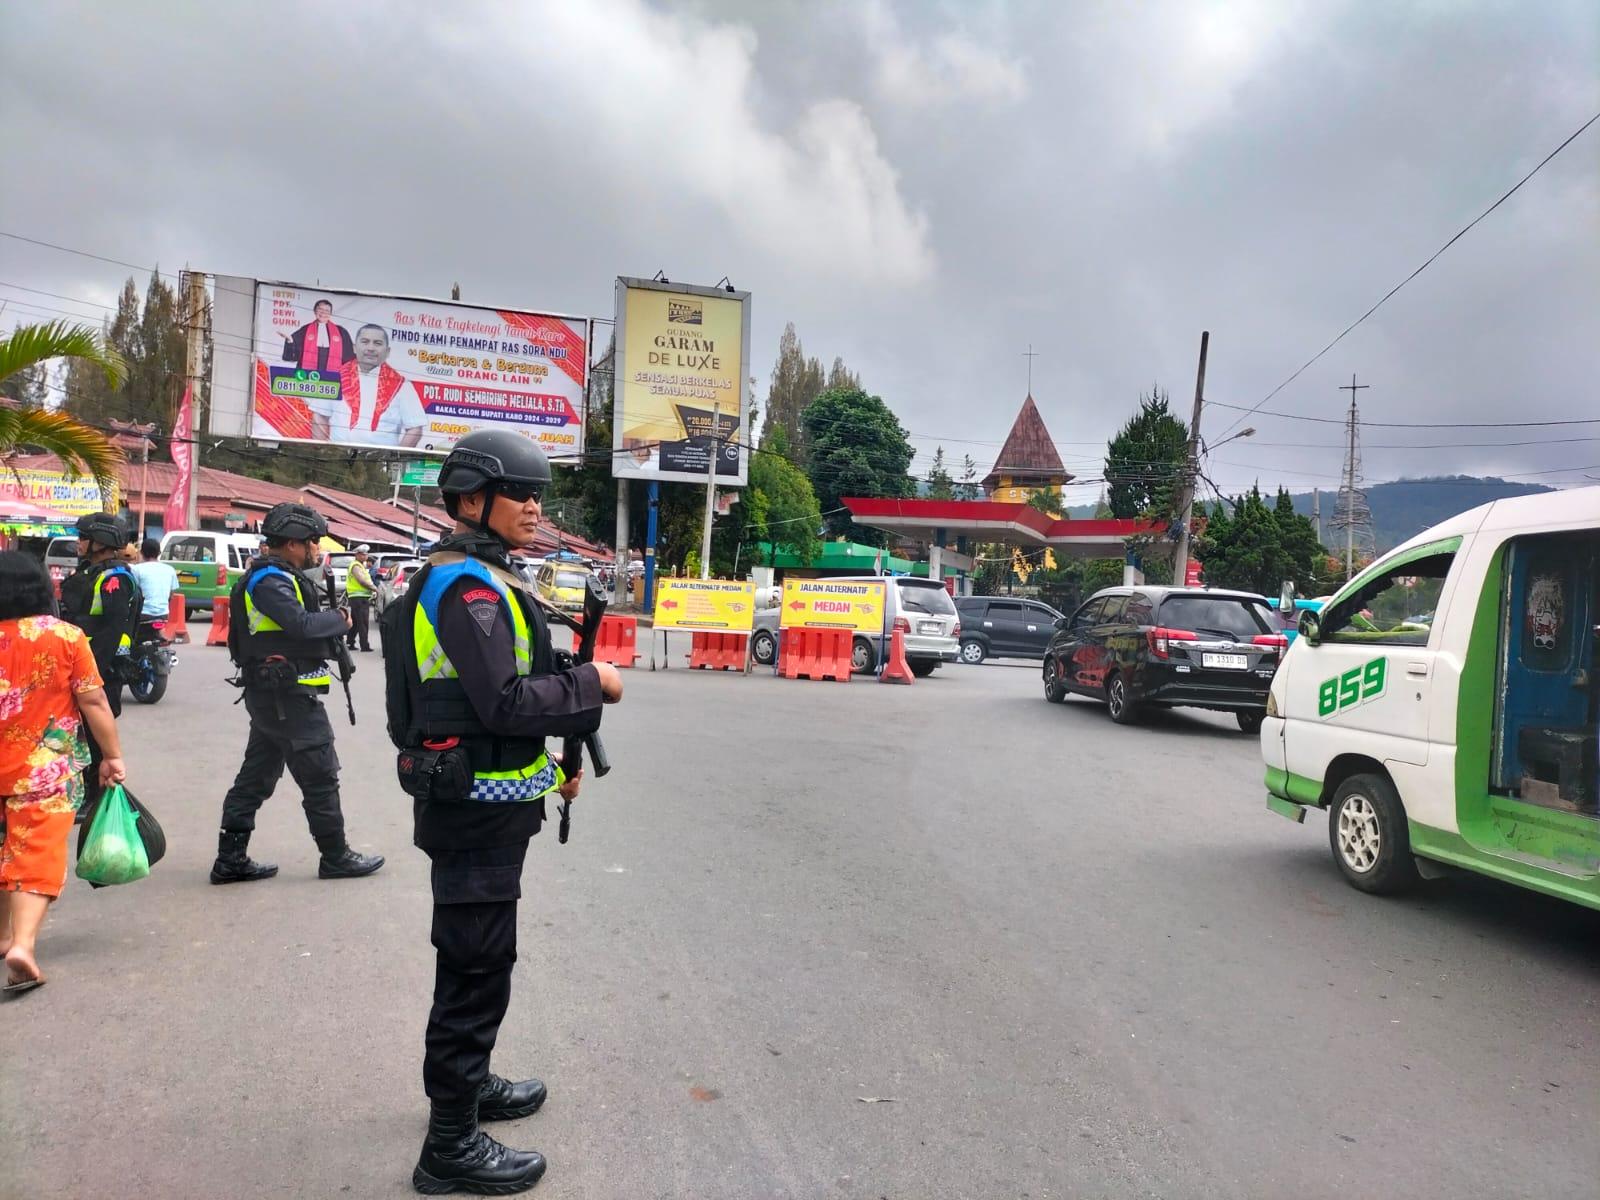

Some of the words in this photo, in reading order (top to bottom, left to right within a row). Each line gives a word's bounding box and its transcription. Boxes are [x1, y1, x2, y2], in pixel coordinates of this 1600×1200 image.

[273, 308, 295, 317] DEWI
[419, 313, 442, 329] Kita
[666, 328, 703, 339] GUDANG
[392, 328, 420, 342] PINDO
[423, 332, 447, 345] KAMI
[450, 336, 499, 352] PENAMPAT
[501, 341, 519, 353] RAS
[522, 344, 546, 357] SORA
[549, 347, 567, 359] NDU
[654, 335, 714, 353] GARAM
[481, 358, 492, 370] &
[496, 358, 549, 376] Berguna
[648, 351, 671, 365] DE
[677, 354, 720, 371] LUXE
[457, 369, 498, 382] ORANG
[634, 371, 678, 386] SENSASI
[680, 374, 732, 390] BERKELAS
[277, 381, 296, 391] 0811
[299, 383, 316, 393] 980
[319, 385, 336, 395] 366
[423, 384, 441, 400] PDT.
[443, 387, 463, 403] RUDI
[464, 389, 508, 407] SEMBIRING
[649, 384, 688, 397] SEMUA
[690, 388, 717, 400] PUAS
[435, 405, 457, 414] BAKAL
[457, 408, 480, 417] CALON
[481, 410, 504, 419] BUPATI
[505, 413, 523, 421] KARO
[524, 414, 540, 422] 2024
[430, 421, 471, 434] KARO
[538, 431, 575, 446] JUAH
[689, 583, 720, 591] ALTERNATIF
[800, 583, 824, 592] JALAN
[824, 585, 868, 594] ALTERNATIF
[814, 601, 851, 613] MEDAN
[1319, 656, 1386, 717] 859
